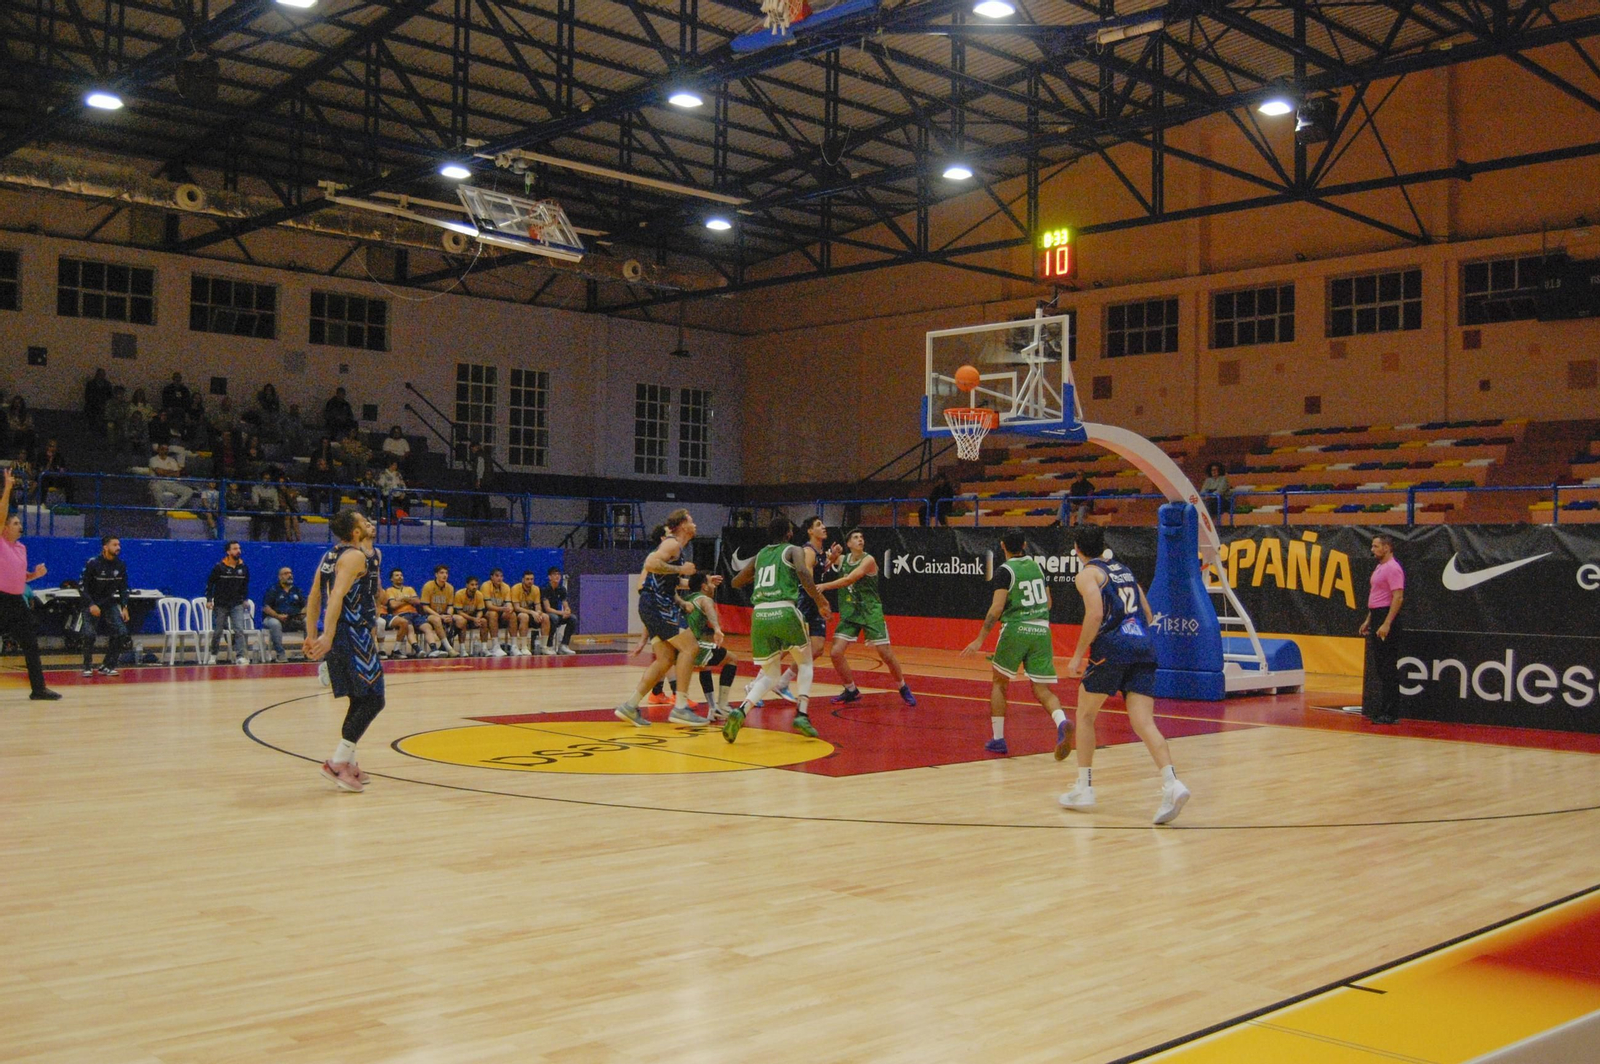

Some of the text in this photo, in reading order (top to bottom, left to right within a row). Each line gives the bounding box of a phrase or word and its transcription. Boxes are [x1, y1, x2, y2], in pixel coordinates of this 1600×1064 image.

[1046, 246, 1068, 276] 10
[754, 564, 776, 589] 10
[912, 555, 985, 575] CaixaBank
[1198, 530, 1358, 611] SPAÑA
[1018, 578, 1048, 607] 30
[1117, 587, 1138, 615] 12
[1164, 618, 1199, 632] IBERO
[1396, 648, 1600, 708] endes
